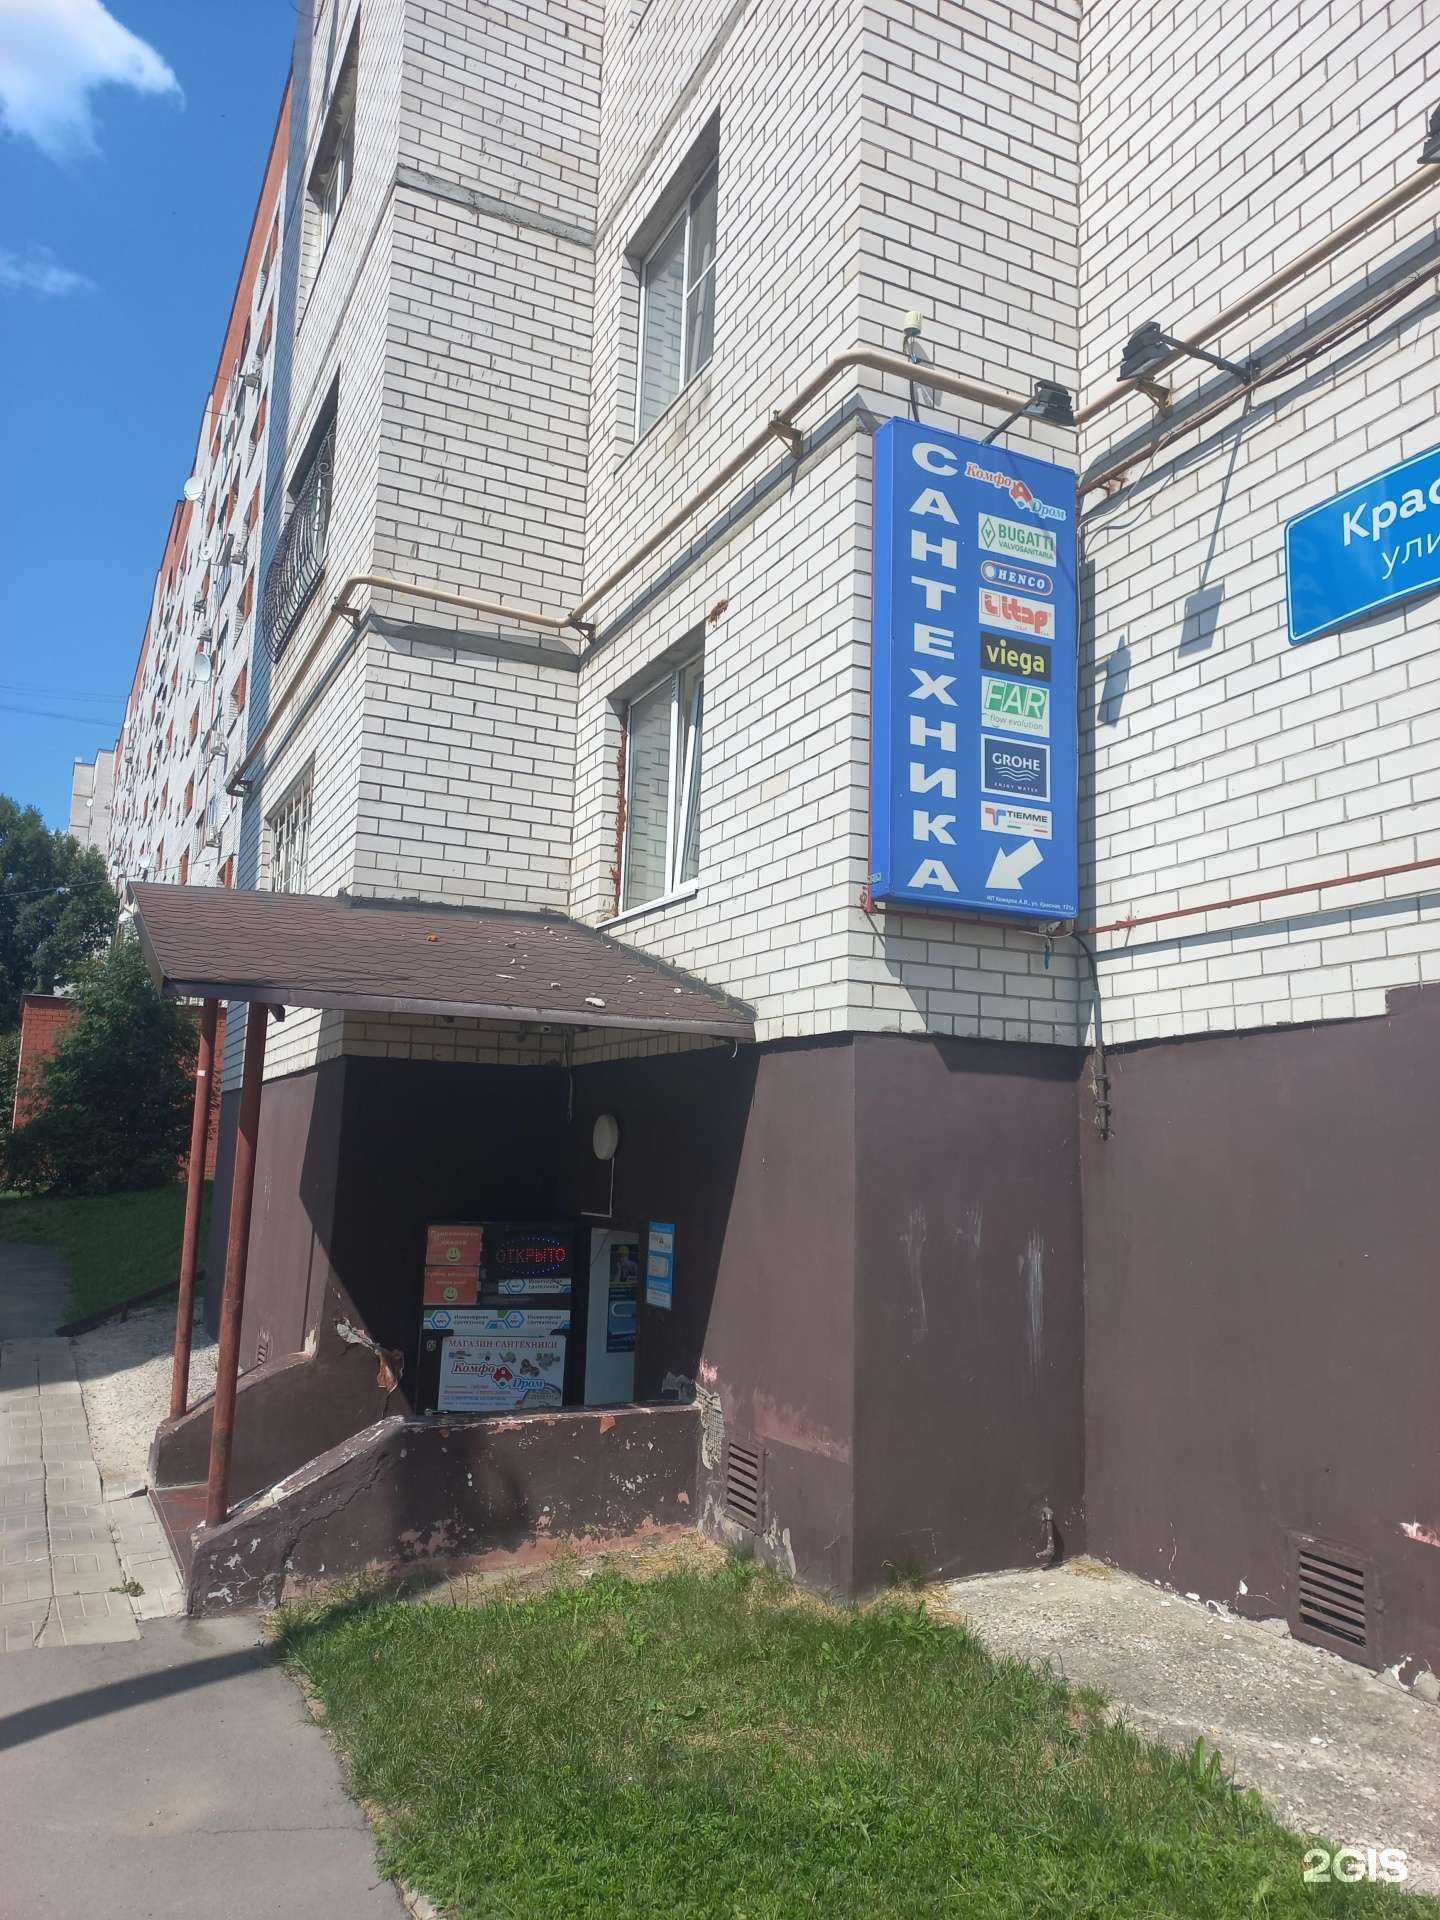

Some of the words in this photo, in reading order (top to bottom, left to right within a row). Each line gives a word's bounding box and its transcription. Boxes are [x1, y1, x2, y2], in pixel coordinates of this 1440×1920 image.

[998, 523, 1054, 552] BUGATTI
[998, 568, 1045, 590] HENCO
[908, 442, 960, 893] САНТЕХНИКА
[986, 640, 1044, 675] viega
[985, 679, 1046, 719] FAR
[992, 752, 1041, 771] GROHE
[1007, 810, 1048, 823] TIEMME
[496, 1247, 567, 1264] ОТКРЫТО
[453, 1362, 496, 1377] Комфо
